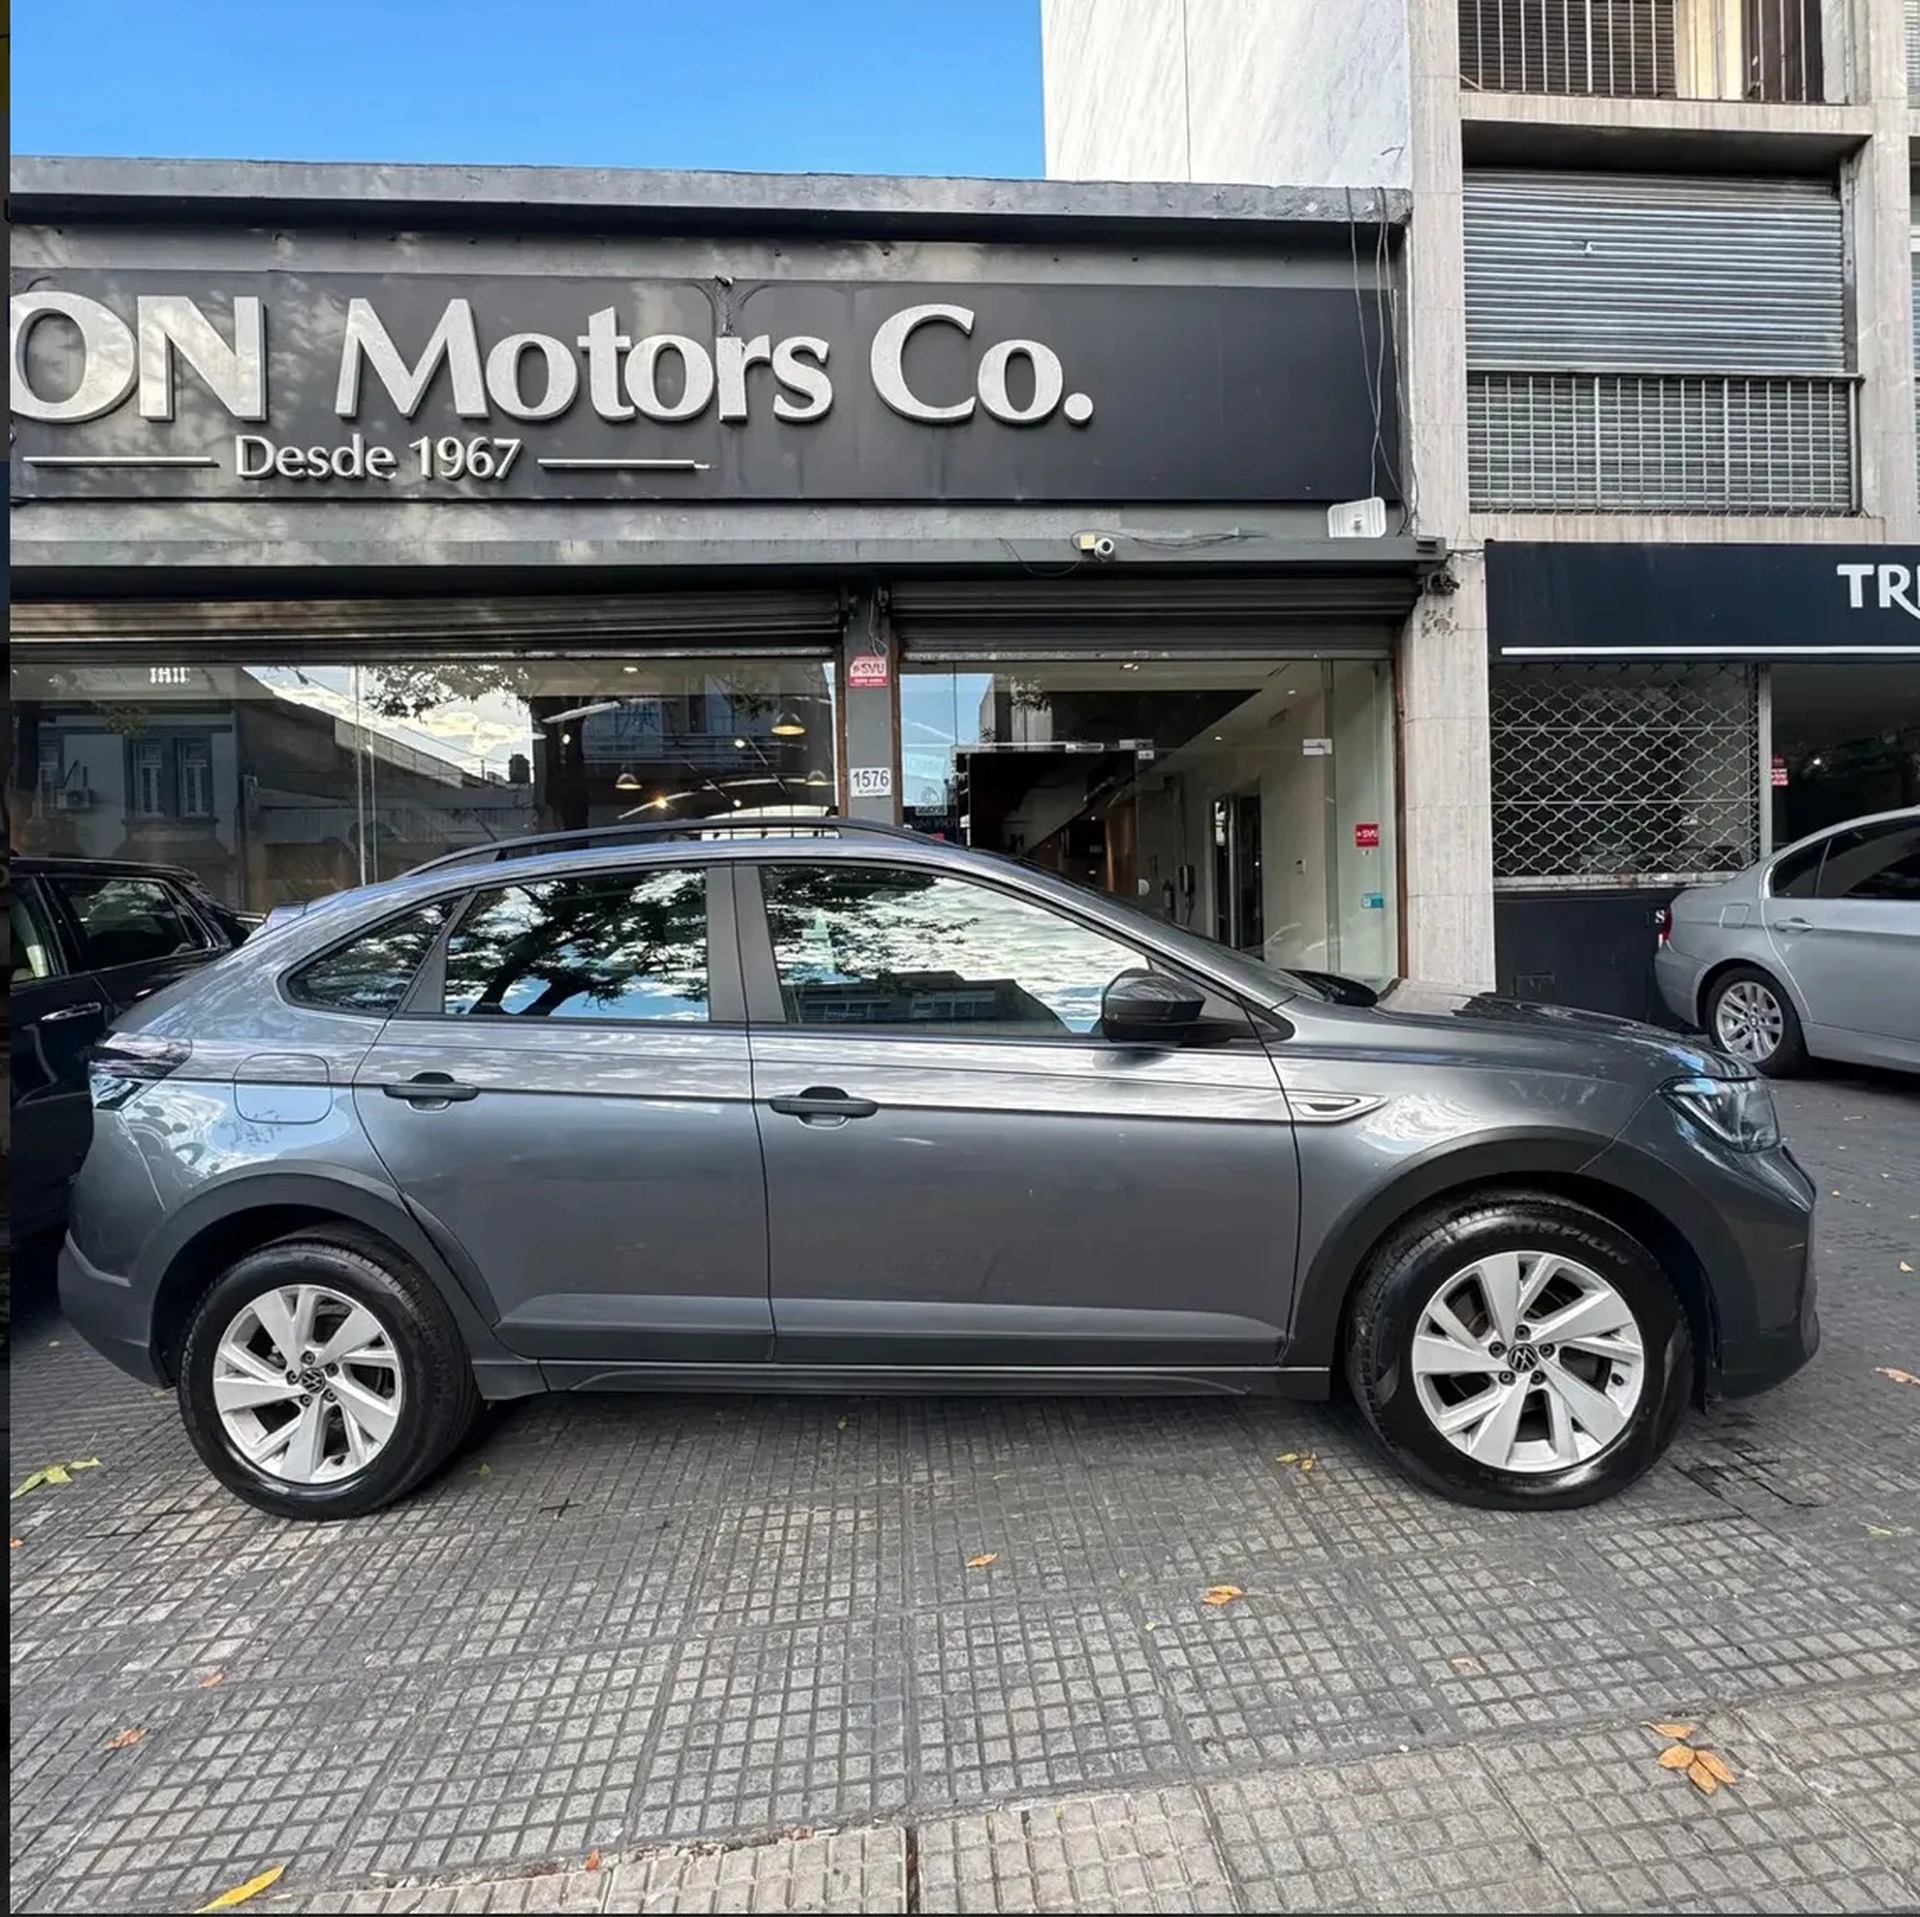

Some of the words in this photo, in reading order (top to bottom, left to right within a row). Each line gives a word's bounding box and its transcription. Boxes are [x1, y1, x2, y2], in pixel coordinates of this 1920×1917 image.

[335, 297, 834, 422] Motors
[870, 303, 1095, 424] Co.
[234, 433, 398, 480] Desde
[408, 435, 522, 480] 1967
[1836, 563, 1920, 620] TR
[852, 769, 890, 788] 1576
